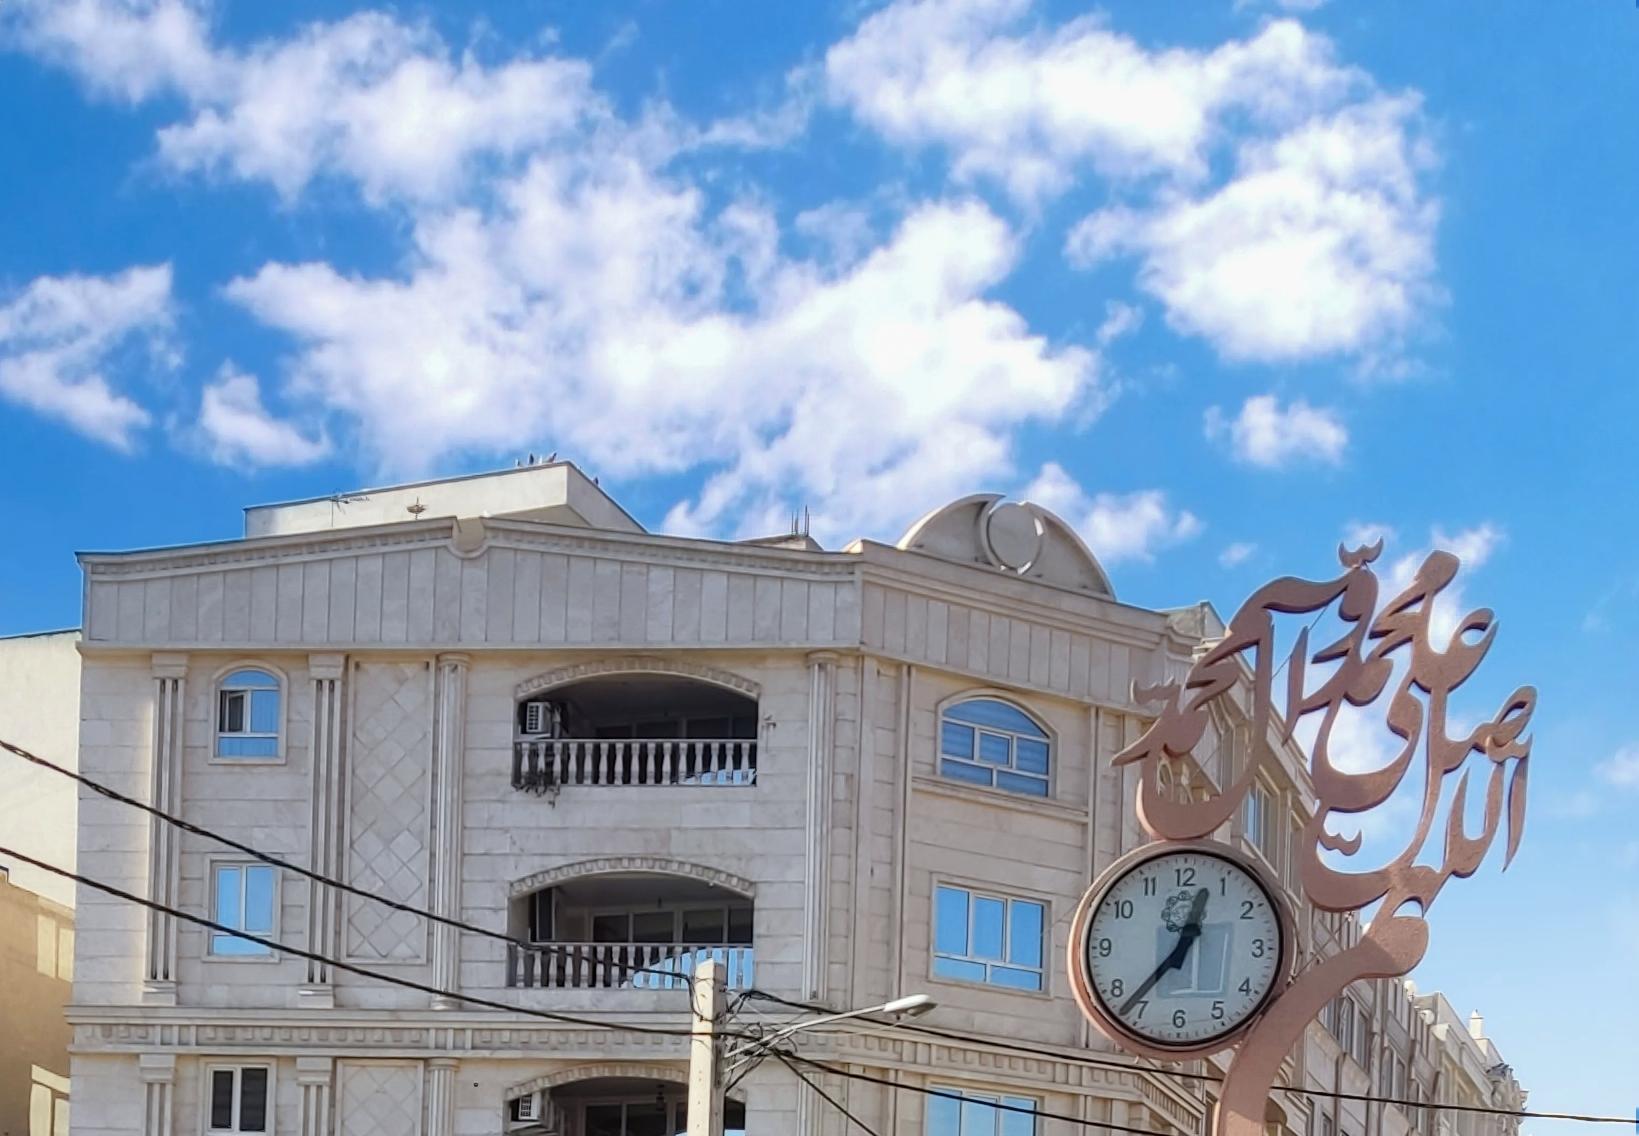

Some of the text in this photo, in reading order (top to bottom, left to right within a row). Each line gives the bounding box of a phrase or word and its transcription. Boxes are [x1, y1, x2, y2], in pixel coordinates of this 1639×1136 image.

[1143, 877, 1157, 896] 11
[1175, 868, 1196, 887] 12
[1220, 877, 1226, 897] 1
[1114, 900, 1134, 919] 10
[1240, 901, 1254, 920] 2
[1099, 938, 1112, 957] 9
[1251, 939, 1264, 958] 3
[1111, 979, 1124, 998] 8
[1238, 978, 1252, 997] 4
[1136, 1001, 1149, 1019] 7
[1173, 1010, 1186, 1028] 6
[1211, 1001, 1225, 1020] 5
